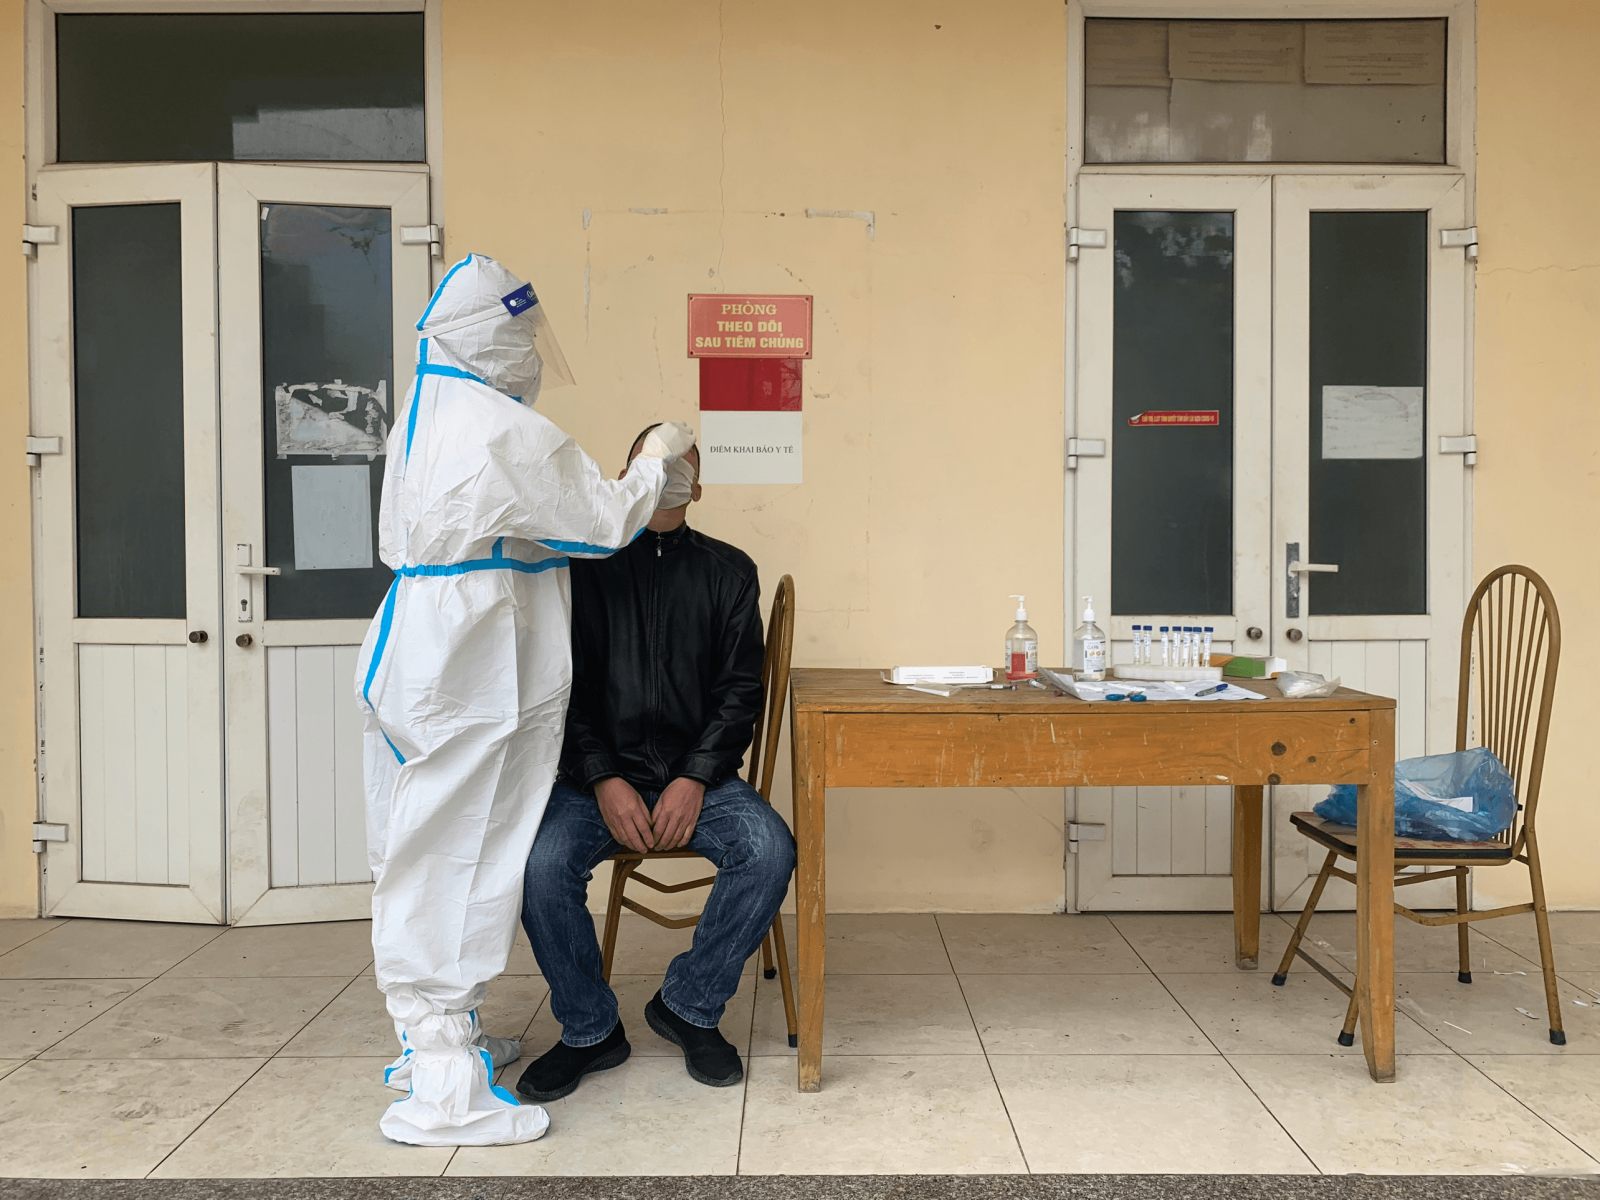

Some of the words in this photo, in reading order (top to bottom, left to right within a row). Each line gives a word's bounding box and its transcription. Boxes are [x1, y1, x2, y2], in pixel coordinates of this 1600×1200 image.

[721, 301, 777, 315] PHÒNG
[717, 321, 753, 332] THEO
[757, 319, 782, 333] DÕI
[695, 336, 721, 348] SAU
[725, 335, 756, 348] TIÊM
[760, 333, 804, 349] CHỦNG
[756, 444, 774, 453] BÁO
